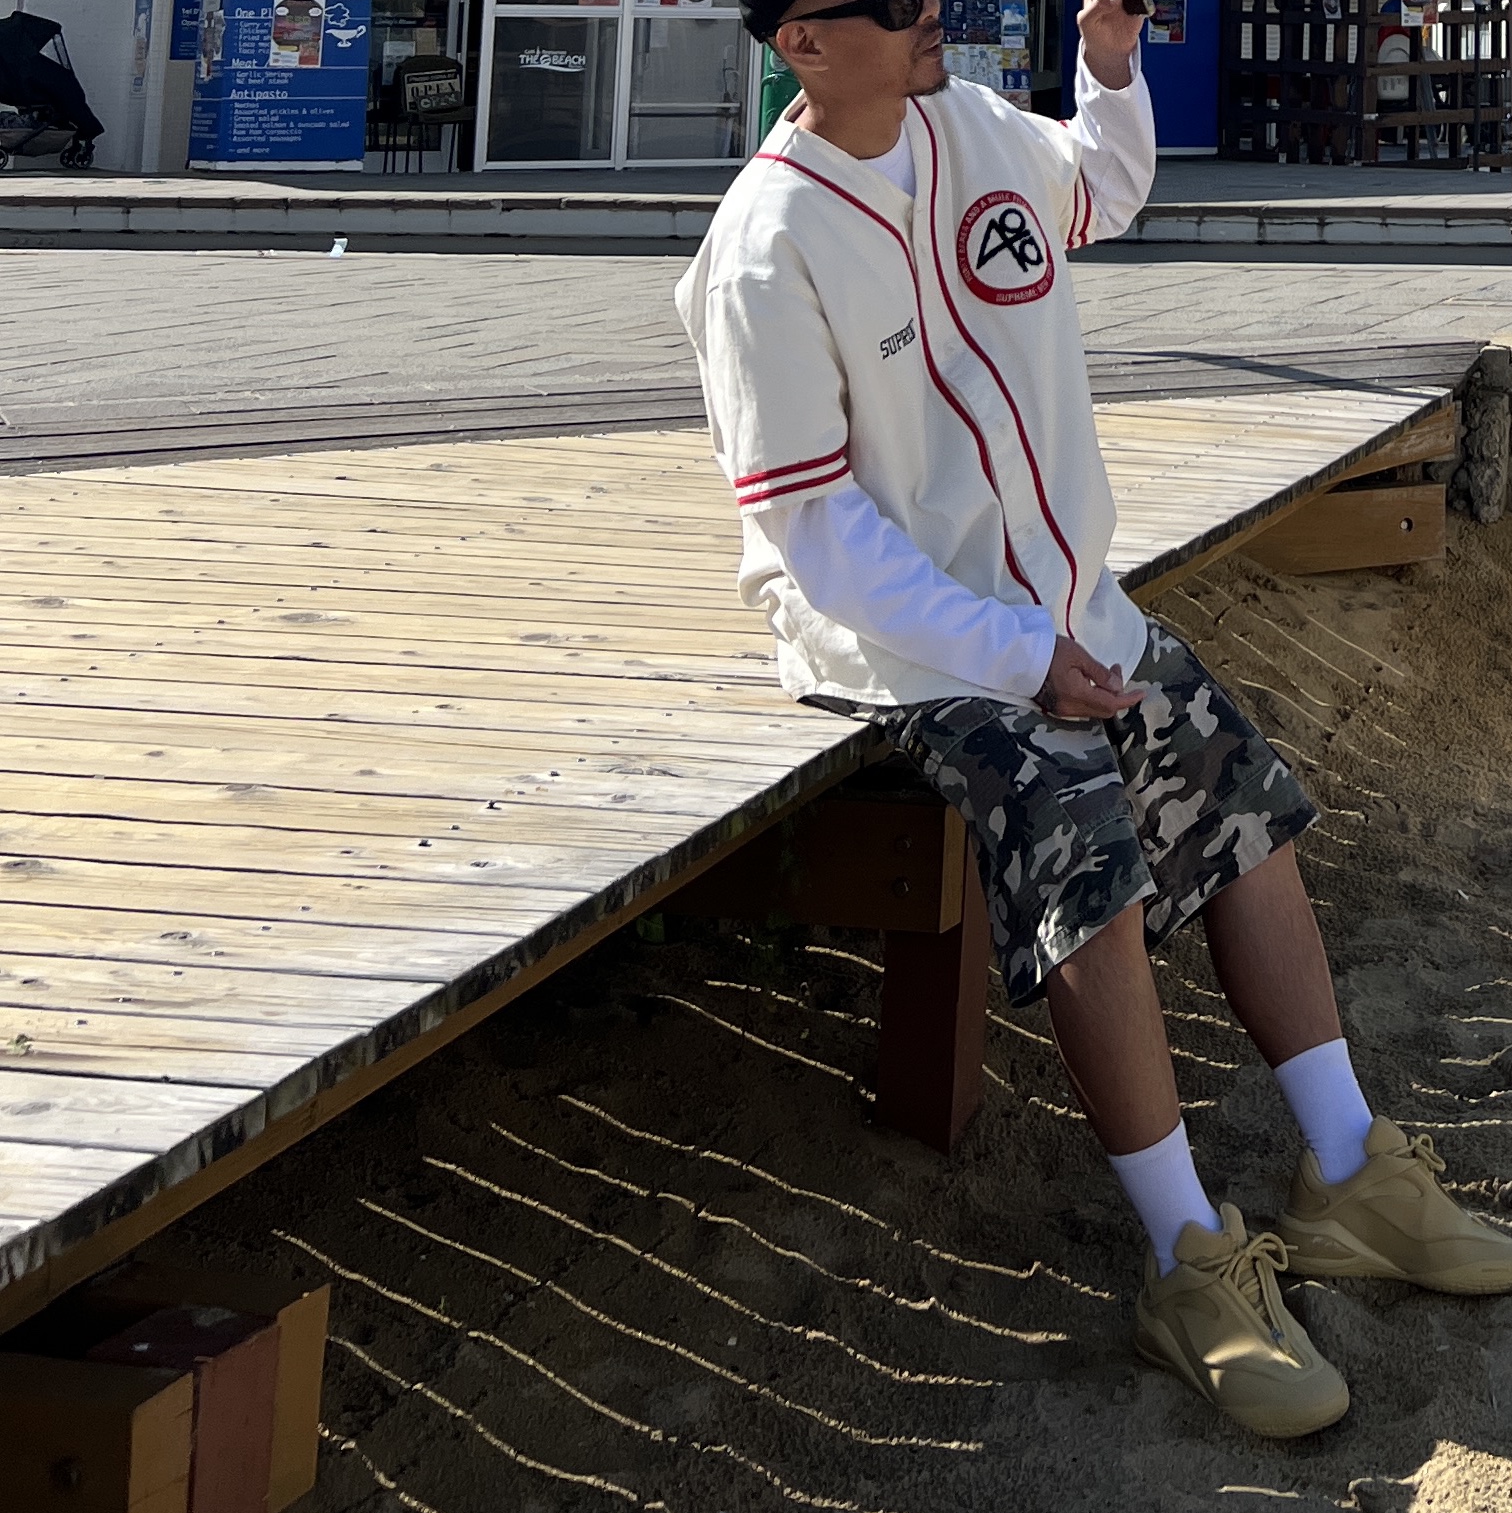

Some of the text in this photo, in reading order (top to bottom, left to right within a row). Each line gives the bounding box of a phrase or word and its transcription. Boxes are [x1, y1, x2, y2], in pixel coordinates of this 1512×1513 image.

[235, 7, 255, 18] One
[232, 58, 257, 68] Meat
[519, 55, 586, 65] THE BEACH
[230, 88, 288, 101] Antipasto
[980, 200, 988, 209] A
